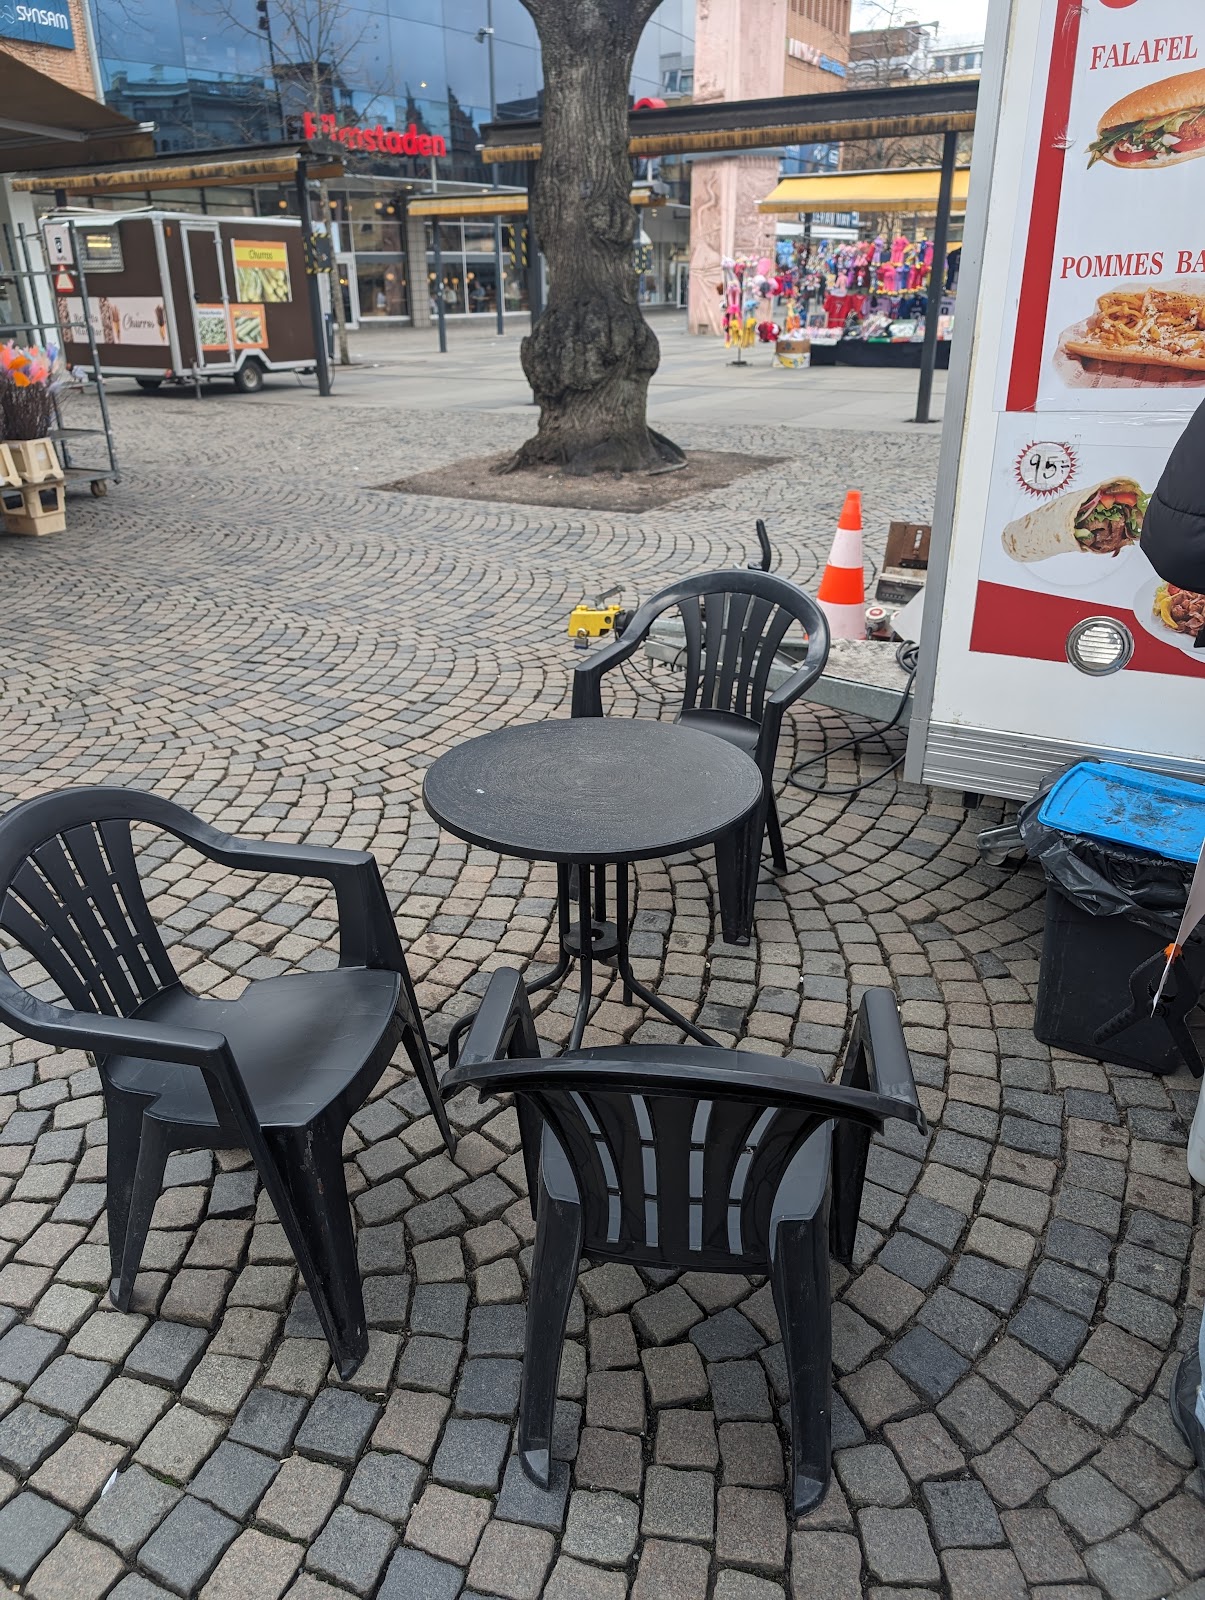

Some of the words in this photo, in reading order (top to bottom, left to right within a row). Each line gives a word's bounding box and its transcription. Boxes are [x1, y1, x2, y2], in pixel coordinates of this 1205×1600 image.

[16, 5, 69, 30] SYNSAM
[1089, 35, 1198, 70] FALAFEL
[303, 111, 446, 157] Filmstaden
[248, 249, 274, 260] Churros
[1060, 252, 1164, 279] POMMES
[122, 312, 156, 333] Churros
